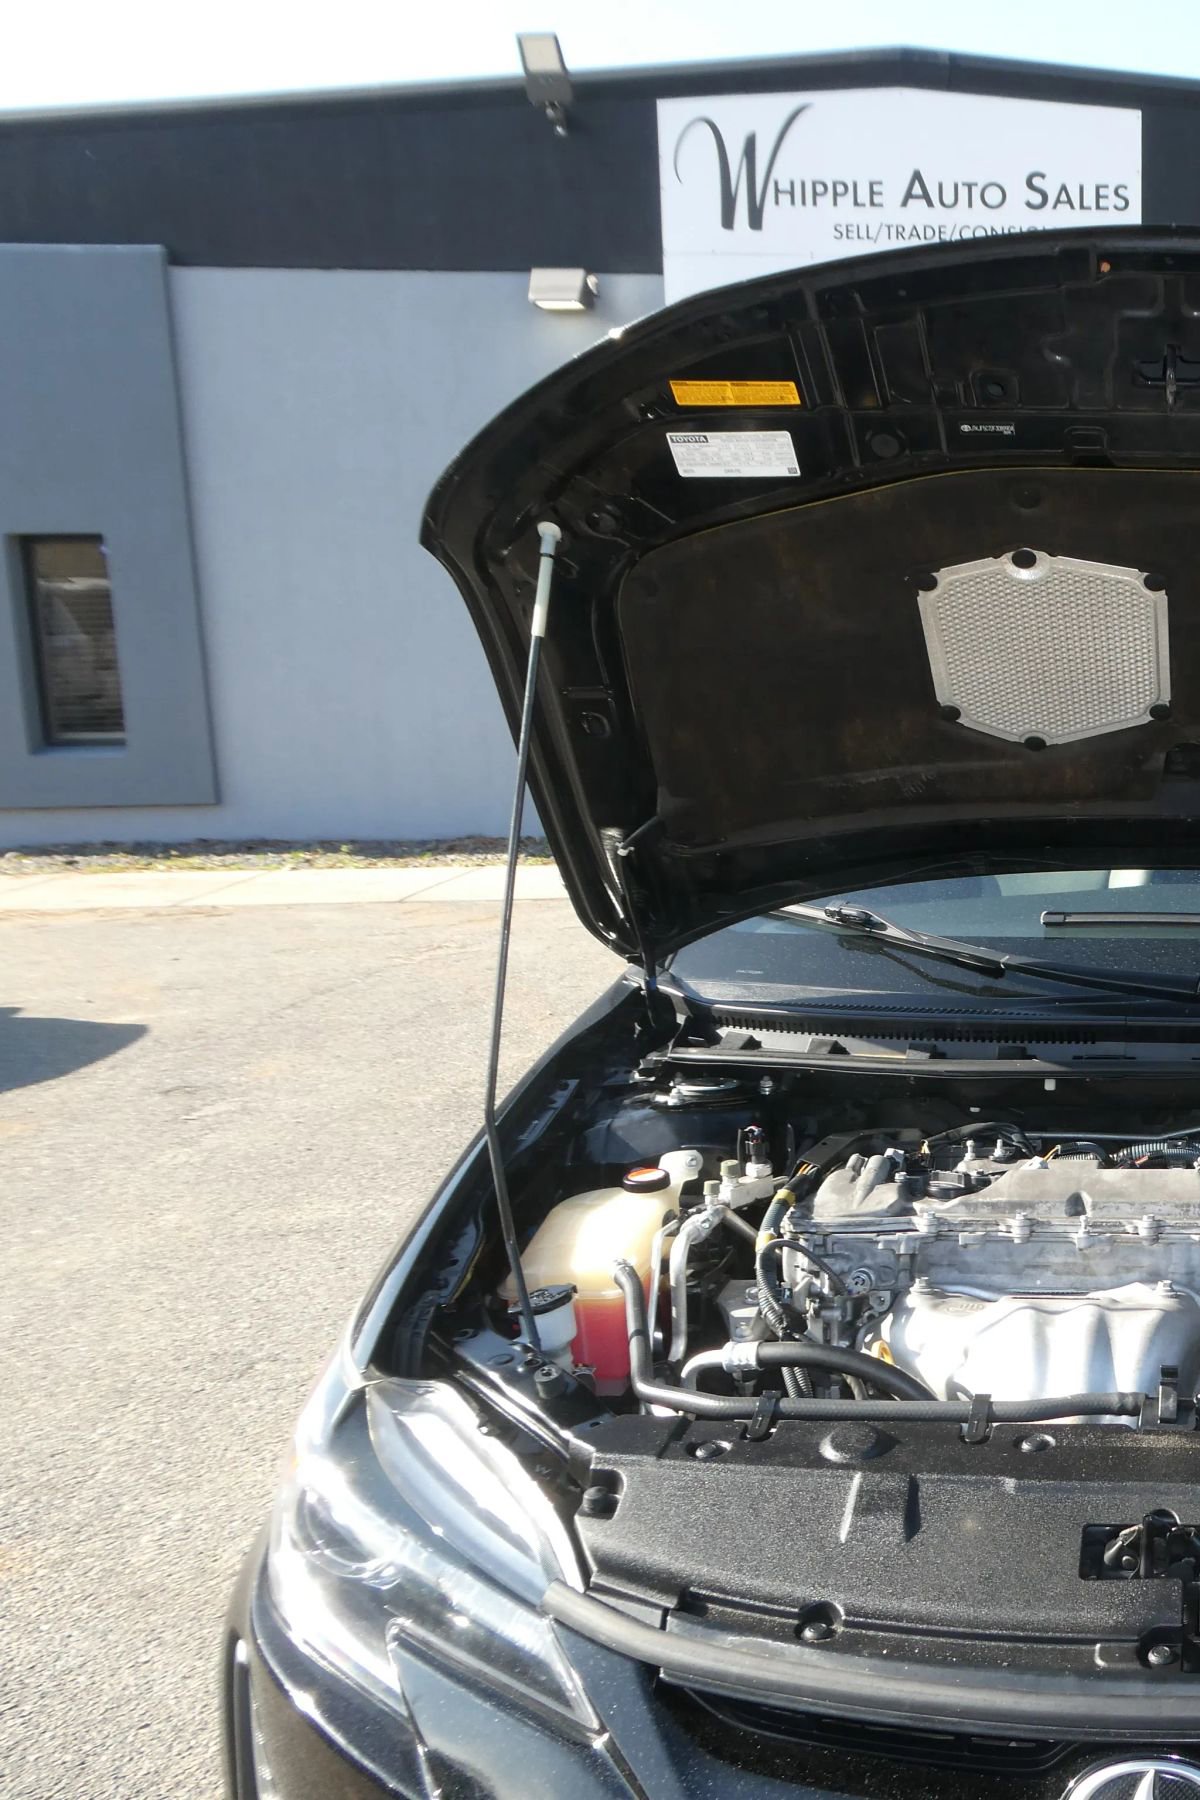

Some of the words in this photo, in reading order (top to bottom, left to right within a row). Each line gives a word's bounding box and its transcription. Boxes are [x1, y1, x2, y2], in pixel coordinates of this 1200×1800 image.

[673, 103, 884, 231] WHIPPLE
[900, 169, 1007, 210] AUTO
[1024, 171, 1130, 212] SALES
[671, 435, 706, 443] TOYOTA
